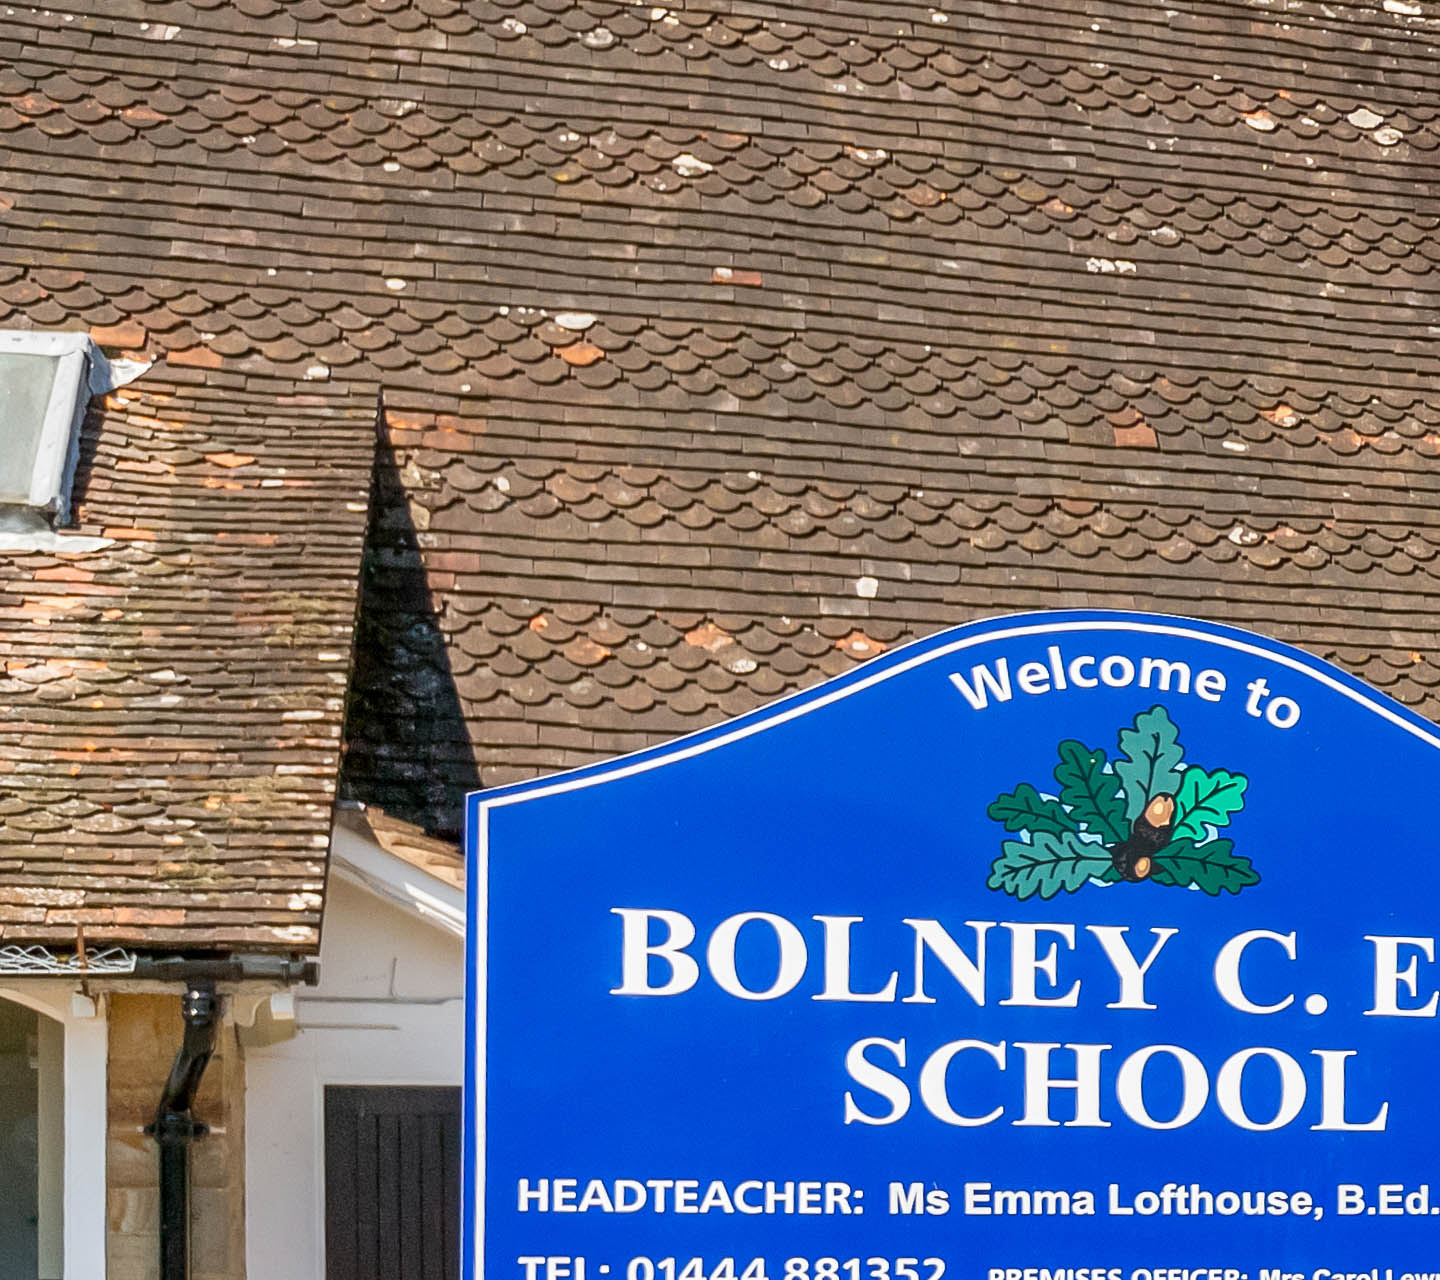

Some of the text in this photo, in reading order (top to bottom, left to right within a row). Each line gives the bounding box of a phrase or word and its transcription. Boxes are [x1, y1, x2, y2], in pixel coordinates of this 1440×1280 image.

[946, 644, 1301, 729] Welcome to
[609, 907, 1179, 1010] BOLNEY
[1214, 929, 1328, 1015] C.
[844, 1037, 1389, 1131] SCHOOL
[518, 1178, 864, 1215] HEADTEACHER:
[889, 1182, 950, 1216] Ms
[964, 1182, 1096, 1215] Emma
[1108, 1183, 1324, 1221] Lofthouse,
[1337, 1183, 1440, 1216] B.Ed.
